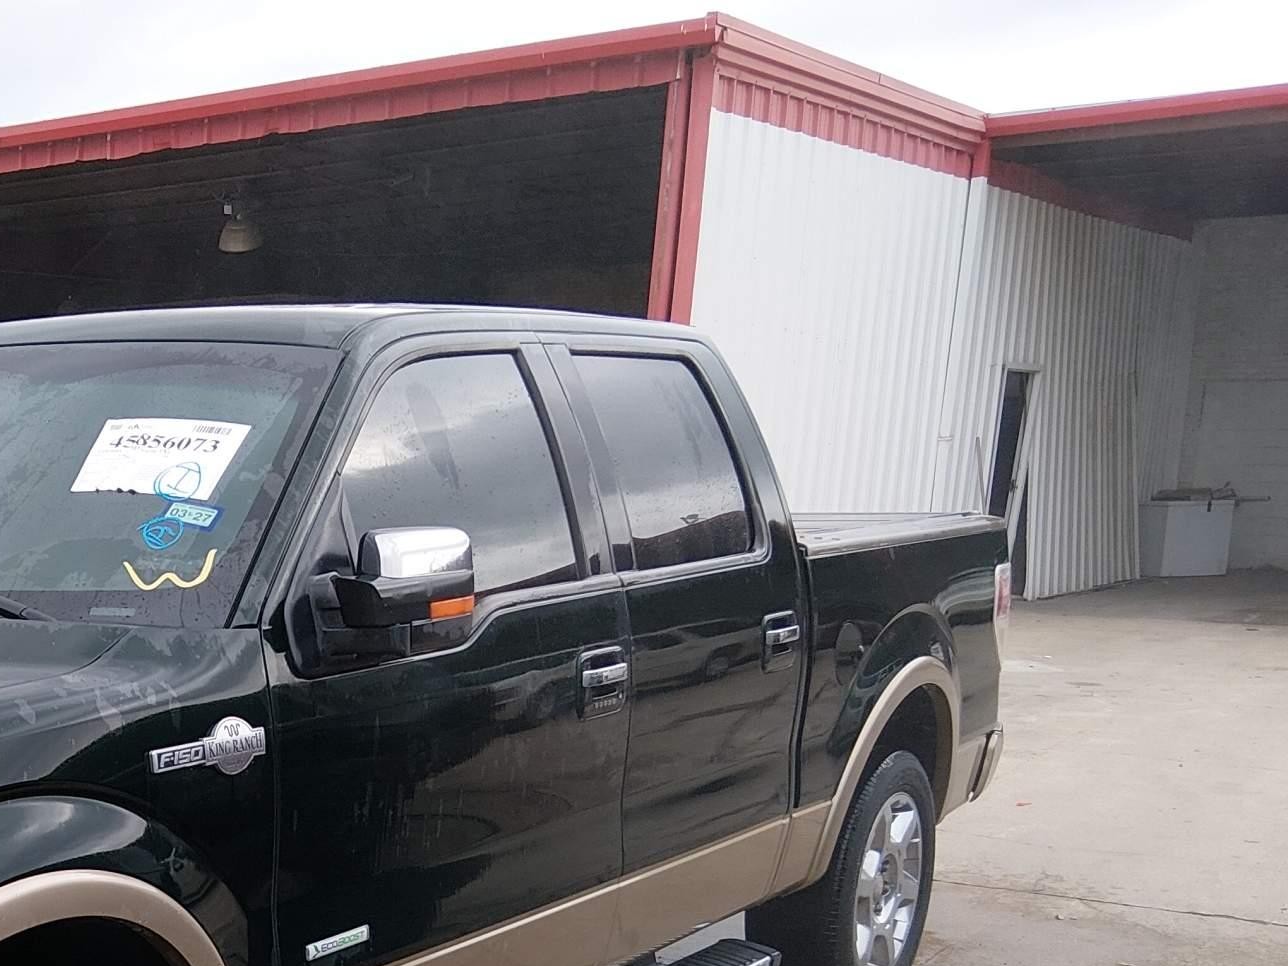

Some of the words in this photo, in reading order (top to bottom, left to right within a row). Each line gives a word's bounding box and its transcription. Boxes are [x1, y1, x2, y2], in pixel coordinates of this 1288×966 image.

[109, 433, 221, 453] 45856073
[170, 507, 188, 518] 03
[192, 511, 213, 522] 27
[207, 739, 232, 759] KING
[232, 730, 264, 753] RANCH
[159, 746, 205, 768] F-150
